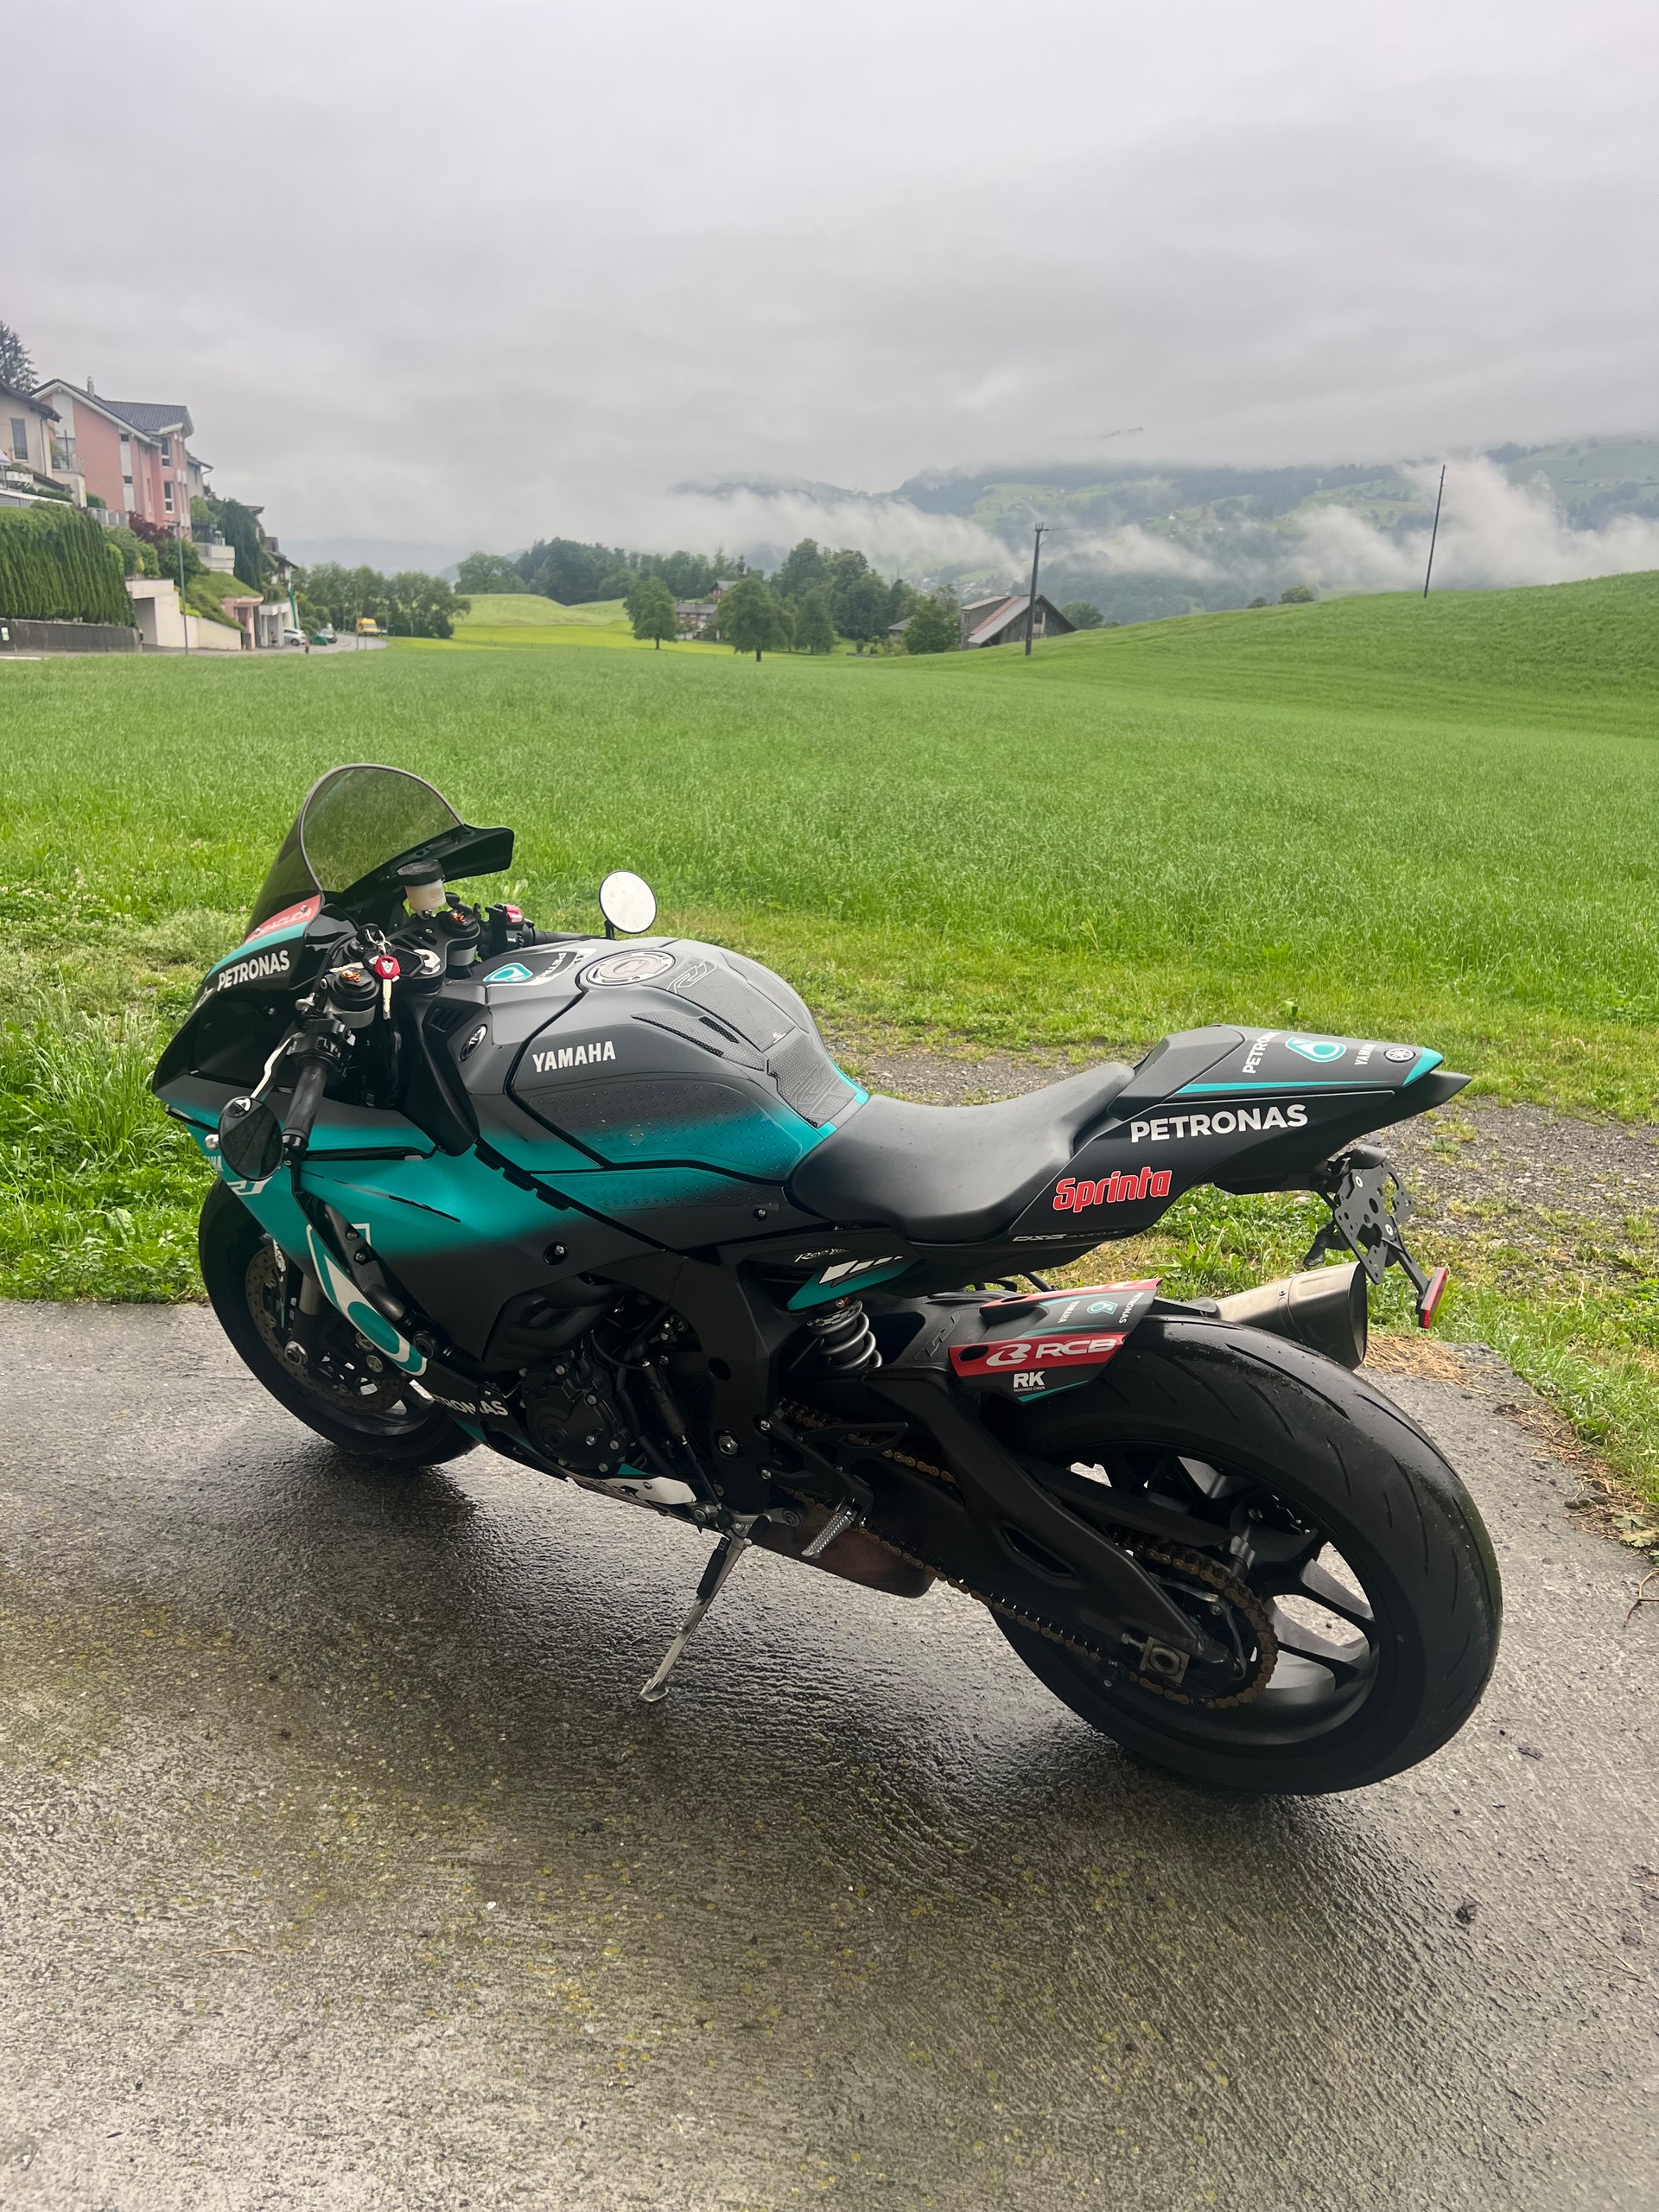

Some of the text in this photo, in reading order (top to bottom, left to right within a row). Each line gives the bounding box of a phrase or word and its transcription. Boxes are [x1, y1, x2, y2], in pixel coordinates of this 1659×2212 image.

[217, 950, 290, 992] PETRONAS
[532, 1040, 616, 1073] YAMAHA
[1130, 1103, 1308, 1143] PETRONAS
[1052, 1166, 1173, 1213] Sprinta
[1035, 1338, 1118, 1359] RCB
[1013, 1370, 1046, 1388] RK
